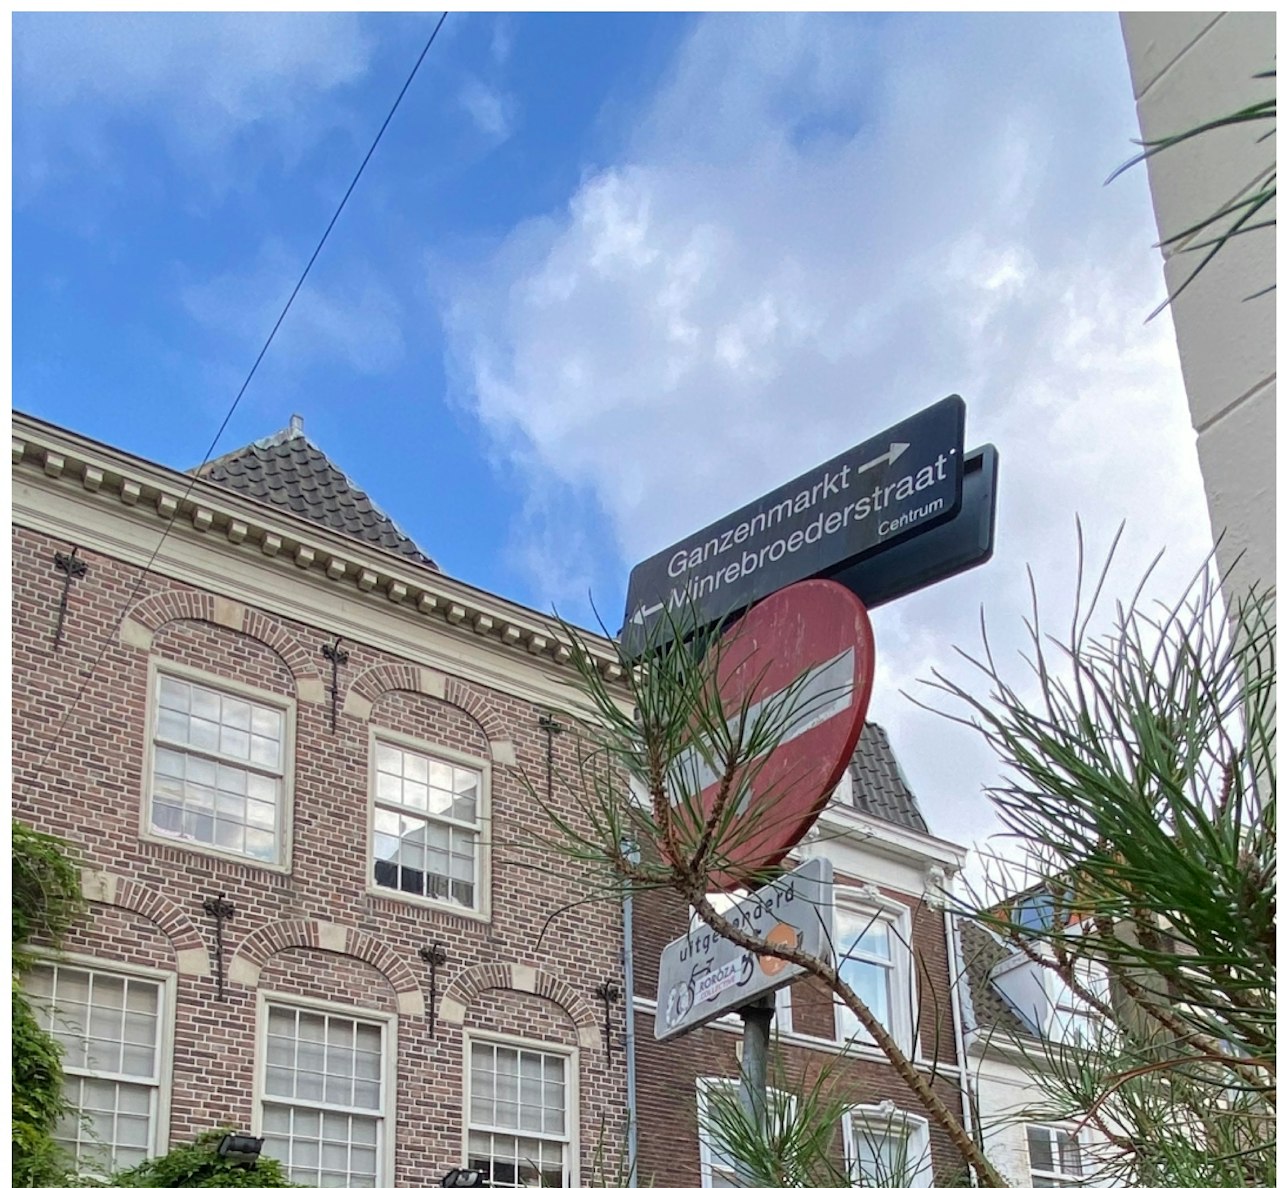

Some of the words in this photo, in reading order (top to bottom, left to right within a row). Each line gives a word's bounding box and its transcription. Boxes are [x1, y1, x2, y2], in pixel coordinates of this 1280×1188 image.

[667, 463, 851, 578] Ganzenmarkt
[668, 454, 947, 613] Minrebroederstraat
[878, 496, 944, 536] Centrum
[679, 882, 795, 962] uitgeonderd
